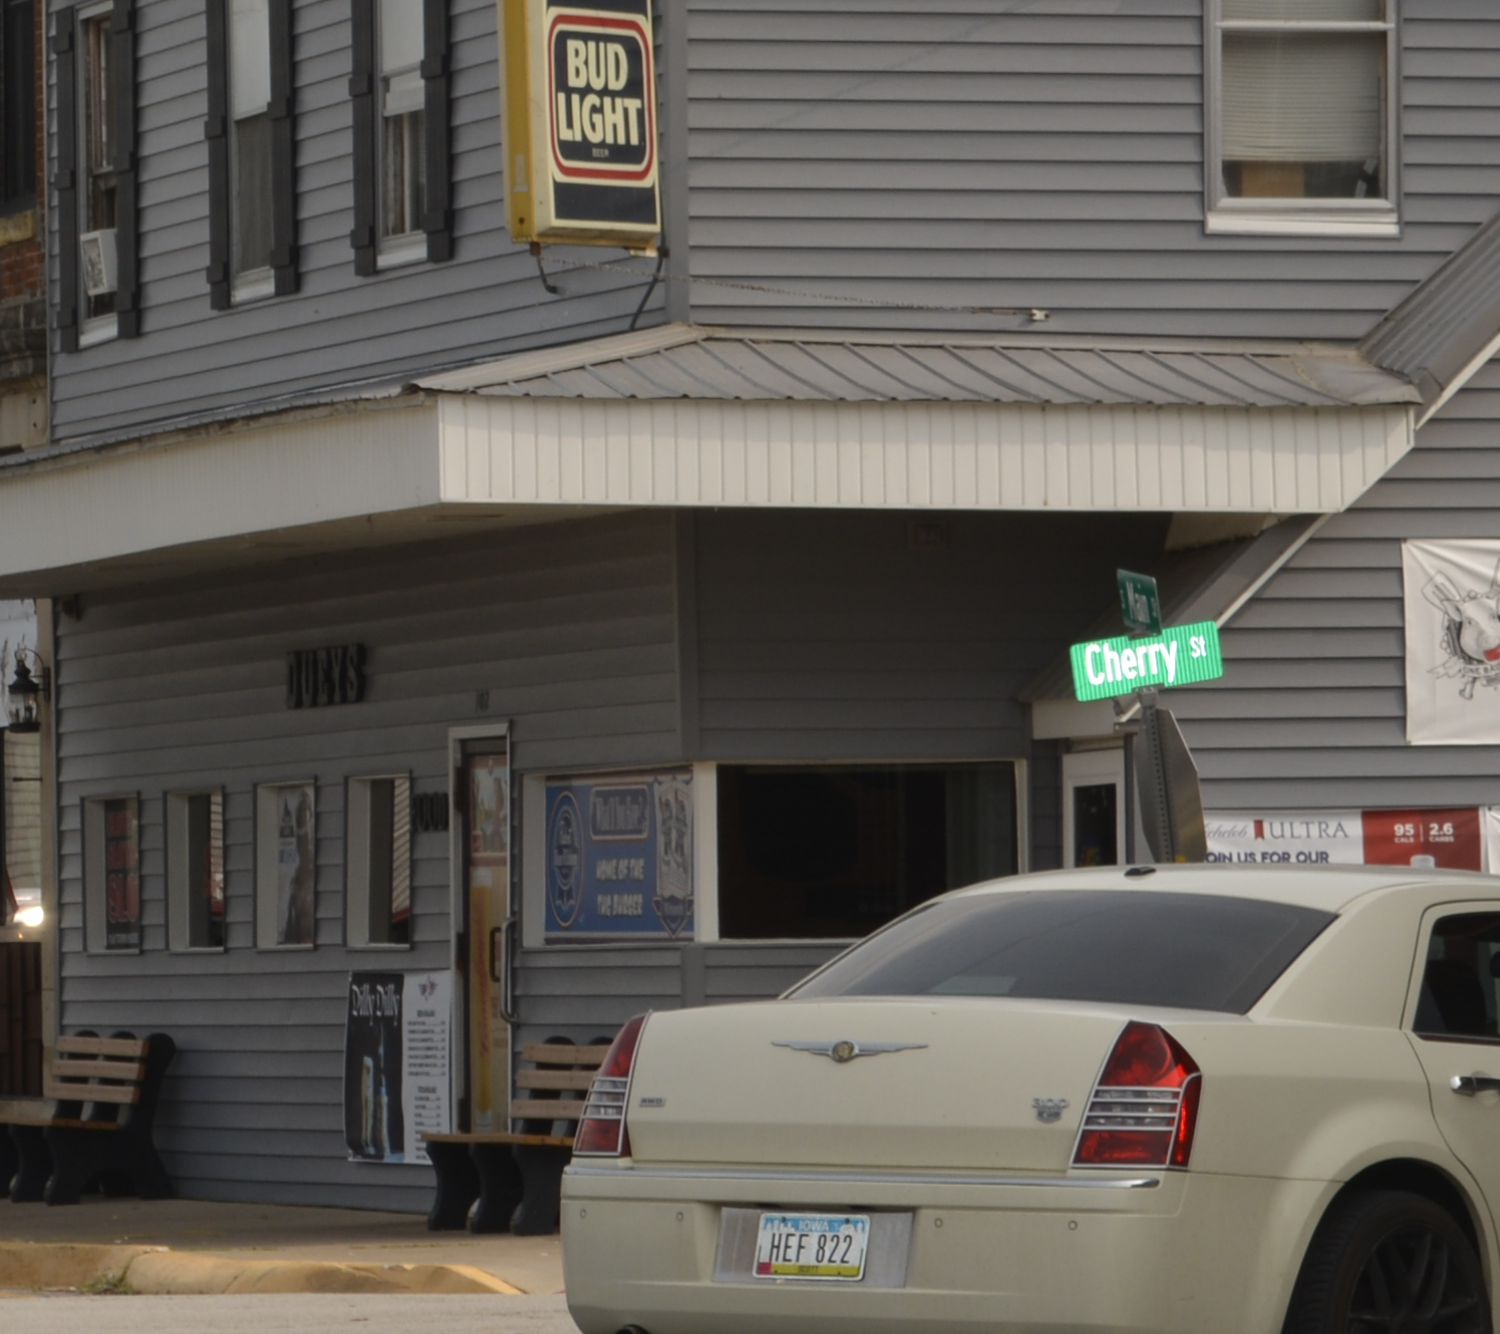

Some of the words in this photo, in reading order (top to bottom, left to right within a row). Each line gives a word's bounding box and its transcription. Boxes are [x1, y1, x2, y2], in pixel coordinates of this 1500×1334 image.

[566, 38, 629, 91] BUD
[557, 92, 643, 146] LIGHT
[1085, 640, 1178, 686] Cherry
[1190, 635, 1207, 658] St
[1268, 820, 1350, 840] ULTRA
[1393, 823, 1415, 836] 95
[1429, 822, 1454, 836] 2.6
[1393, 836, 1415, 844] CALS
[1428, 835, 1455, 843] CARBS
[1205, 851, 1233, 864] OIN
[1237, 851, 1257, 864] US
[1262, 851, 1291, 864] FOR
[1296, 850, 1329, 864] OUR
[351, 983, 375, 1026] Dilly
[375, 983, 400, 1026] Dilly
[799, 1219, 830, 1233] IOWA
[768, 1232, 810, 1263] HEF
[815, 1233, 853, 1264] 822
